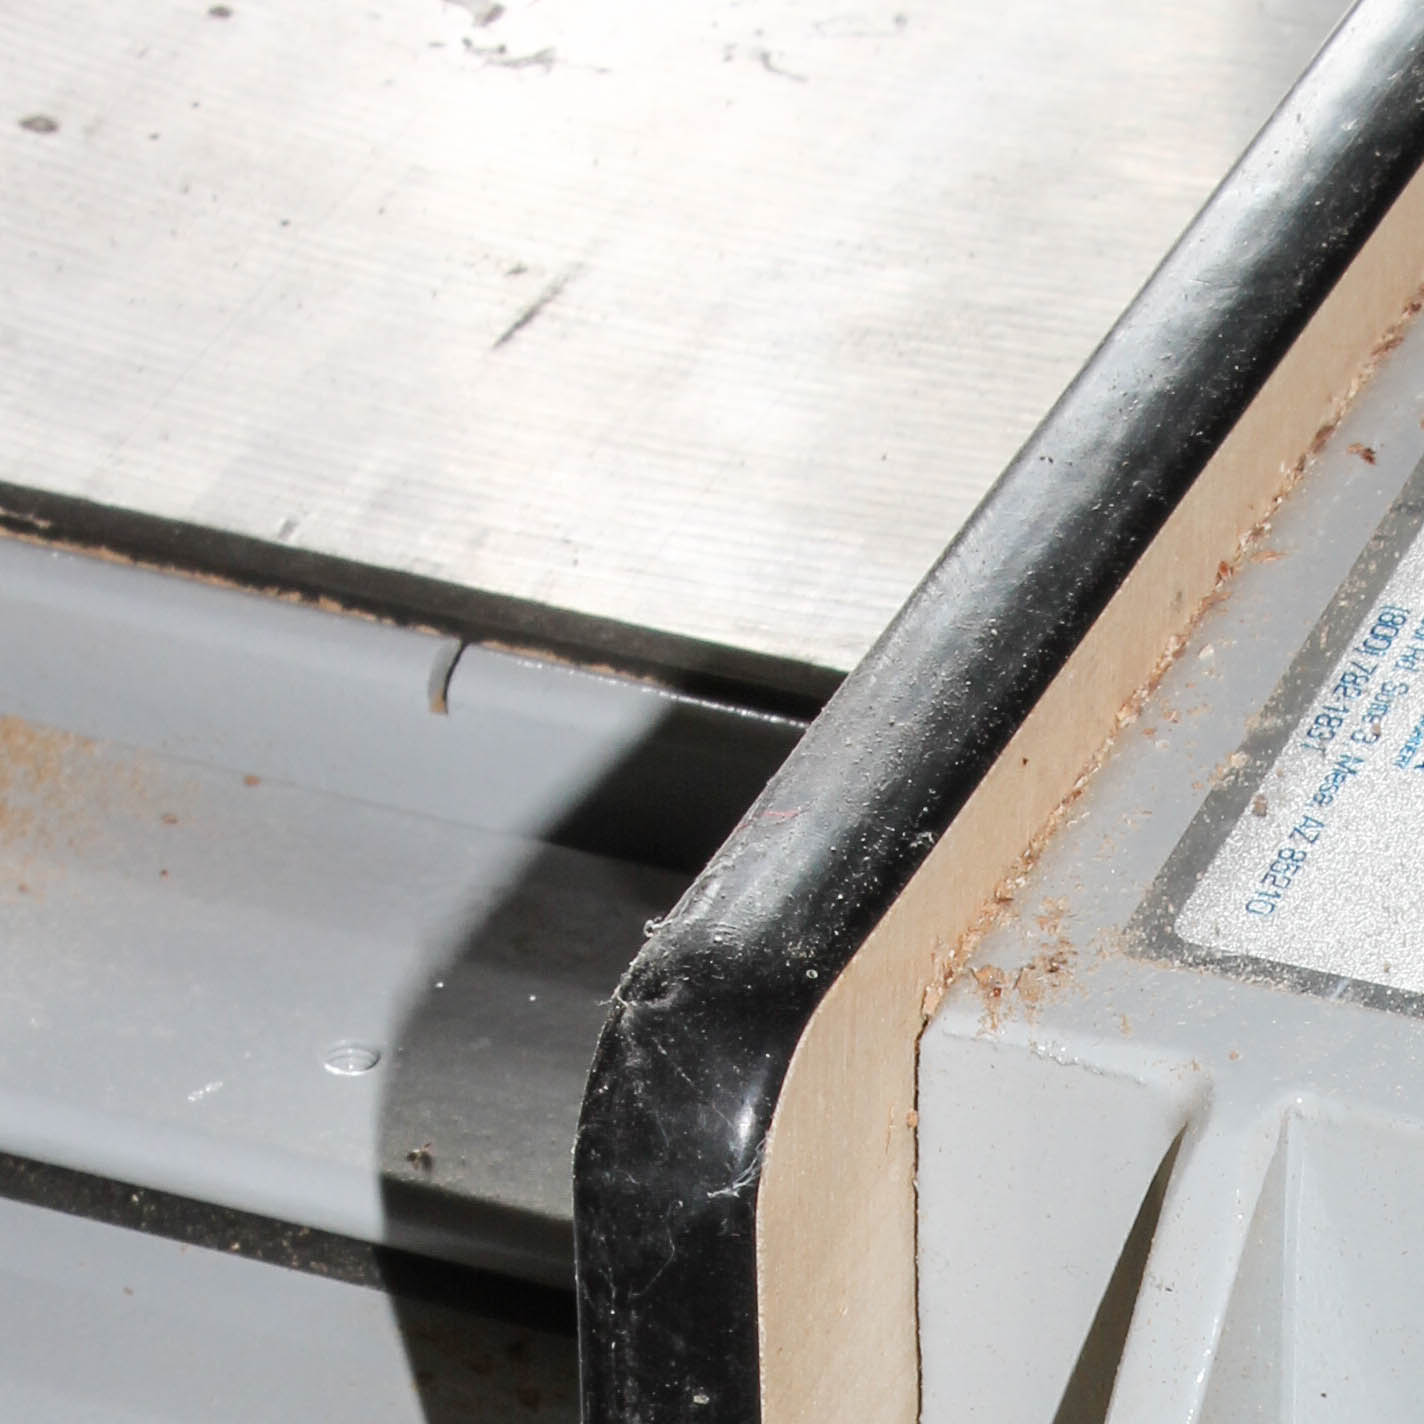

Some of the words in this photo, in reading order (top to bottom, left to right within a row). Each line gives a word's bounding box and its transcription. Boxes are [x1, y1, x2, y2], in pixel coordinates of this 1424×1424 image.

[1351, 603, 1413, 658] (800)
[1296, 659, 1380, 754] 782-1831
[1286, 814, 1328, 844] AZ
[1241, 845, 1310, 917] 85210
